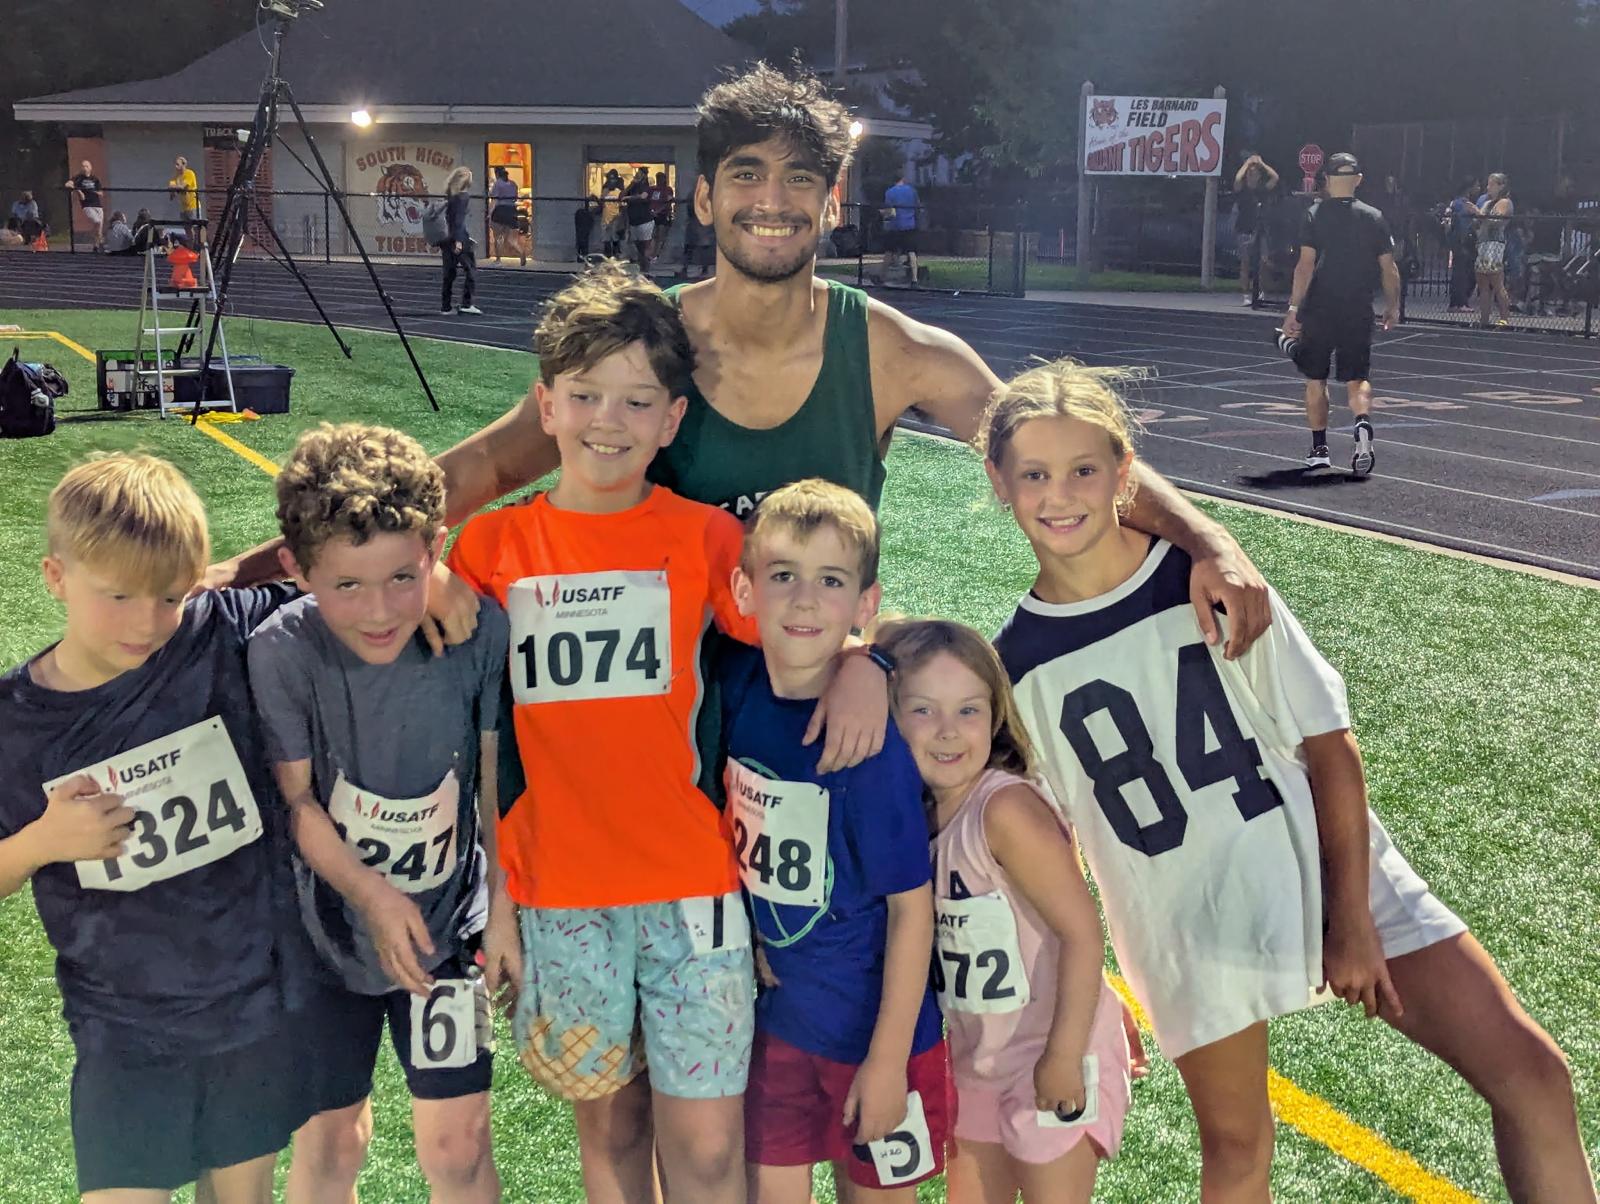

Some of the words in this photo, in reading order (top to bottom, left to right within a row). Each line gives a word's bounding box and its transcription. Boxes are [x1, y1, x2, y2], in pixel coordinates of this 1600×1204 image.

[1130, 99, 1148, 110] LES
[1151, 99, 1198, 111] BARNARD
[1127, 112, 1168, 127] FIELD
[1128, 111, 1221, 172] TIGERS
[356, 146, 406, 172] SOUTH
[416, 147, 454, 171] HIGH
[1301, 153, 1321, 164] STOP
[562, 586, 625, 603] USATF
[555, 608, 608, 619] MINNESOTA
[518, 627, 661, 688] 1074
[1060, 641, 1284, 857] 84
[119, 749, 182, 783] USATF
[739, 783, 783, 808] USATF
[381, 803, 439, 822] USATF
[935, 913, 969, 929] ATF
[422, 986, 456, 1062] 6
